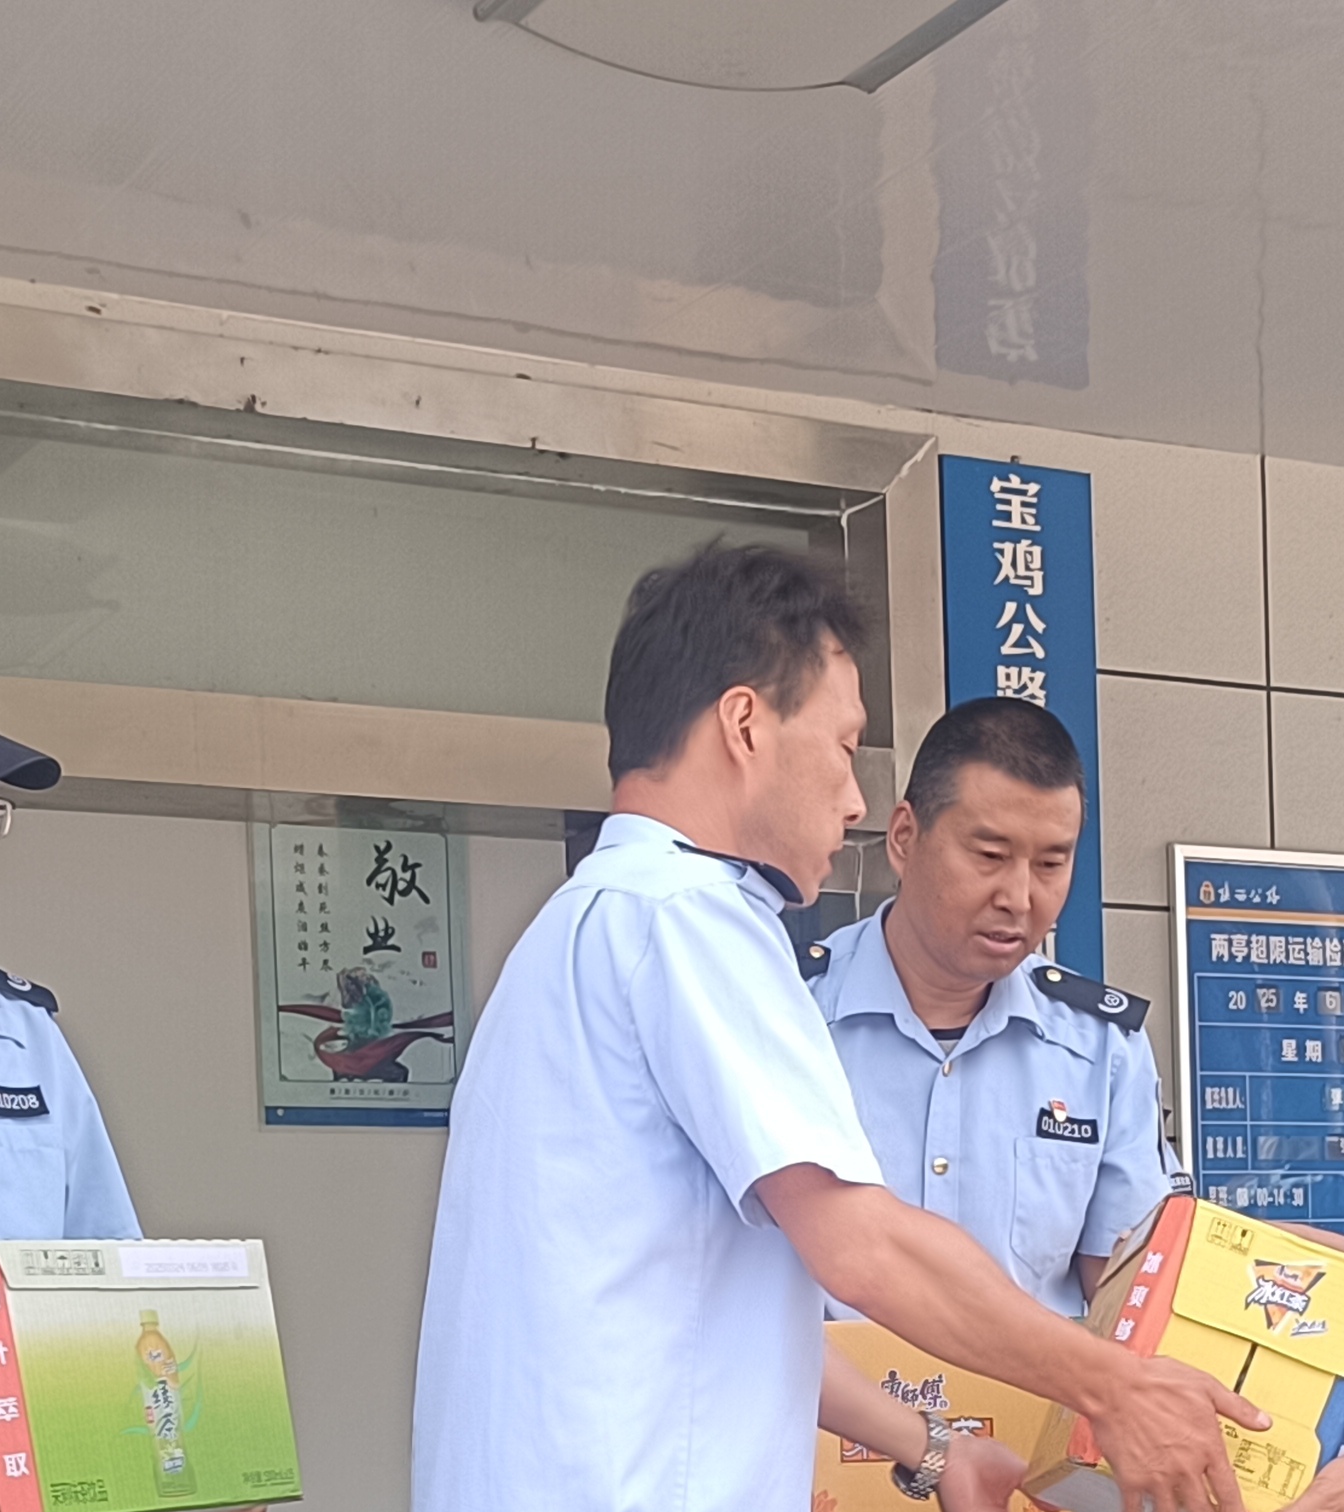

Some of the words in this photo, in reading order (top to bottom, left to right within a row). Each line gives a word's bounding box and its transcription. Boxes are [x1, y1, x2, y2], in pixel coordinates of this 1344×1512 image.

[990, 473, 1047, 708] 宝鸡公路
[363, 839, 431, 956] 敬业
[1041, 1116, 1092, 1138] 010210
